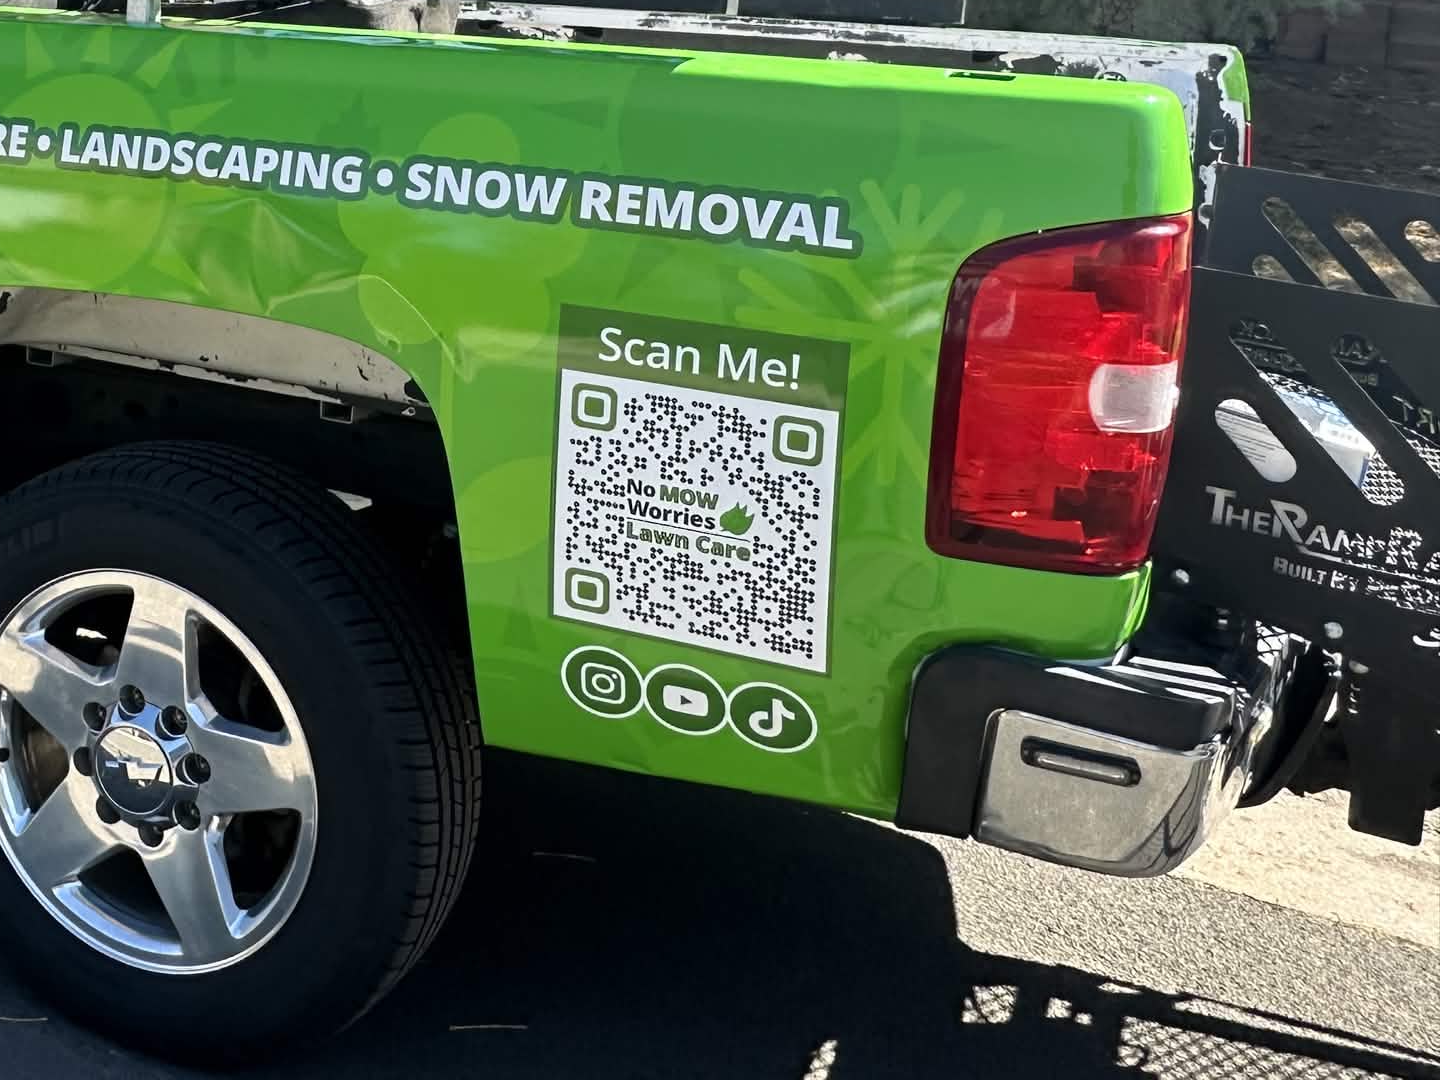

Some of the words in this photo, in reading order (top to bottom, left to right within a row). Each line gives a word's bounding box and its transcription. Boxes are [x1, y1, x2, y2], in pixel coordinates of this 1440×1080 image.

[60, 128, 363, 193] LANDSCAPING
[405, 162, 567, 216] SNOW
[579, 179, 854, 250] REMOVAL
[598, 327, 701, 375] Scan
[717, 343, 801, 390] Me!
[626, 478, 656, 498] No
[659, 484, 719, 510] MOW
[626, 498, 716, 530] Worries
[626, 521, 689, 550] Lawn
[695, 535, 751, 561] Care
